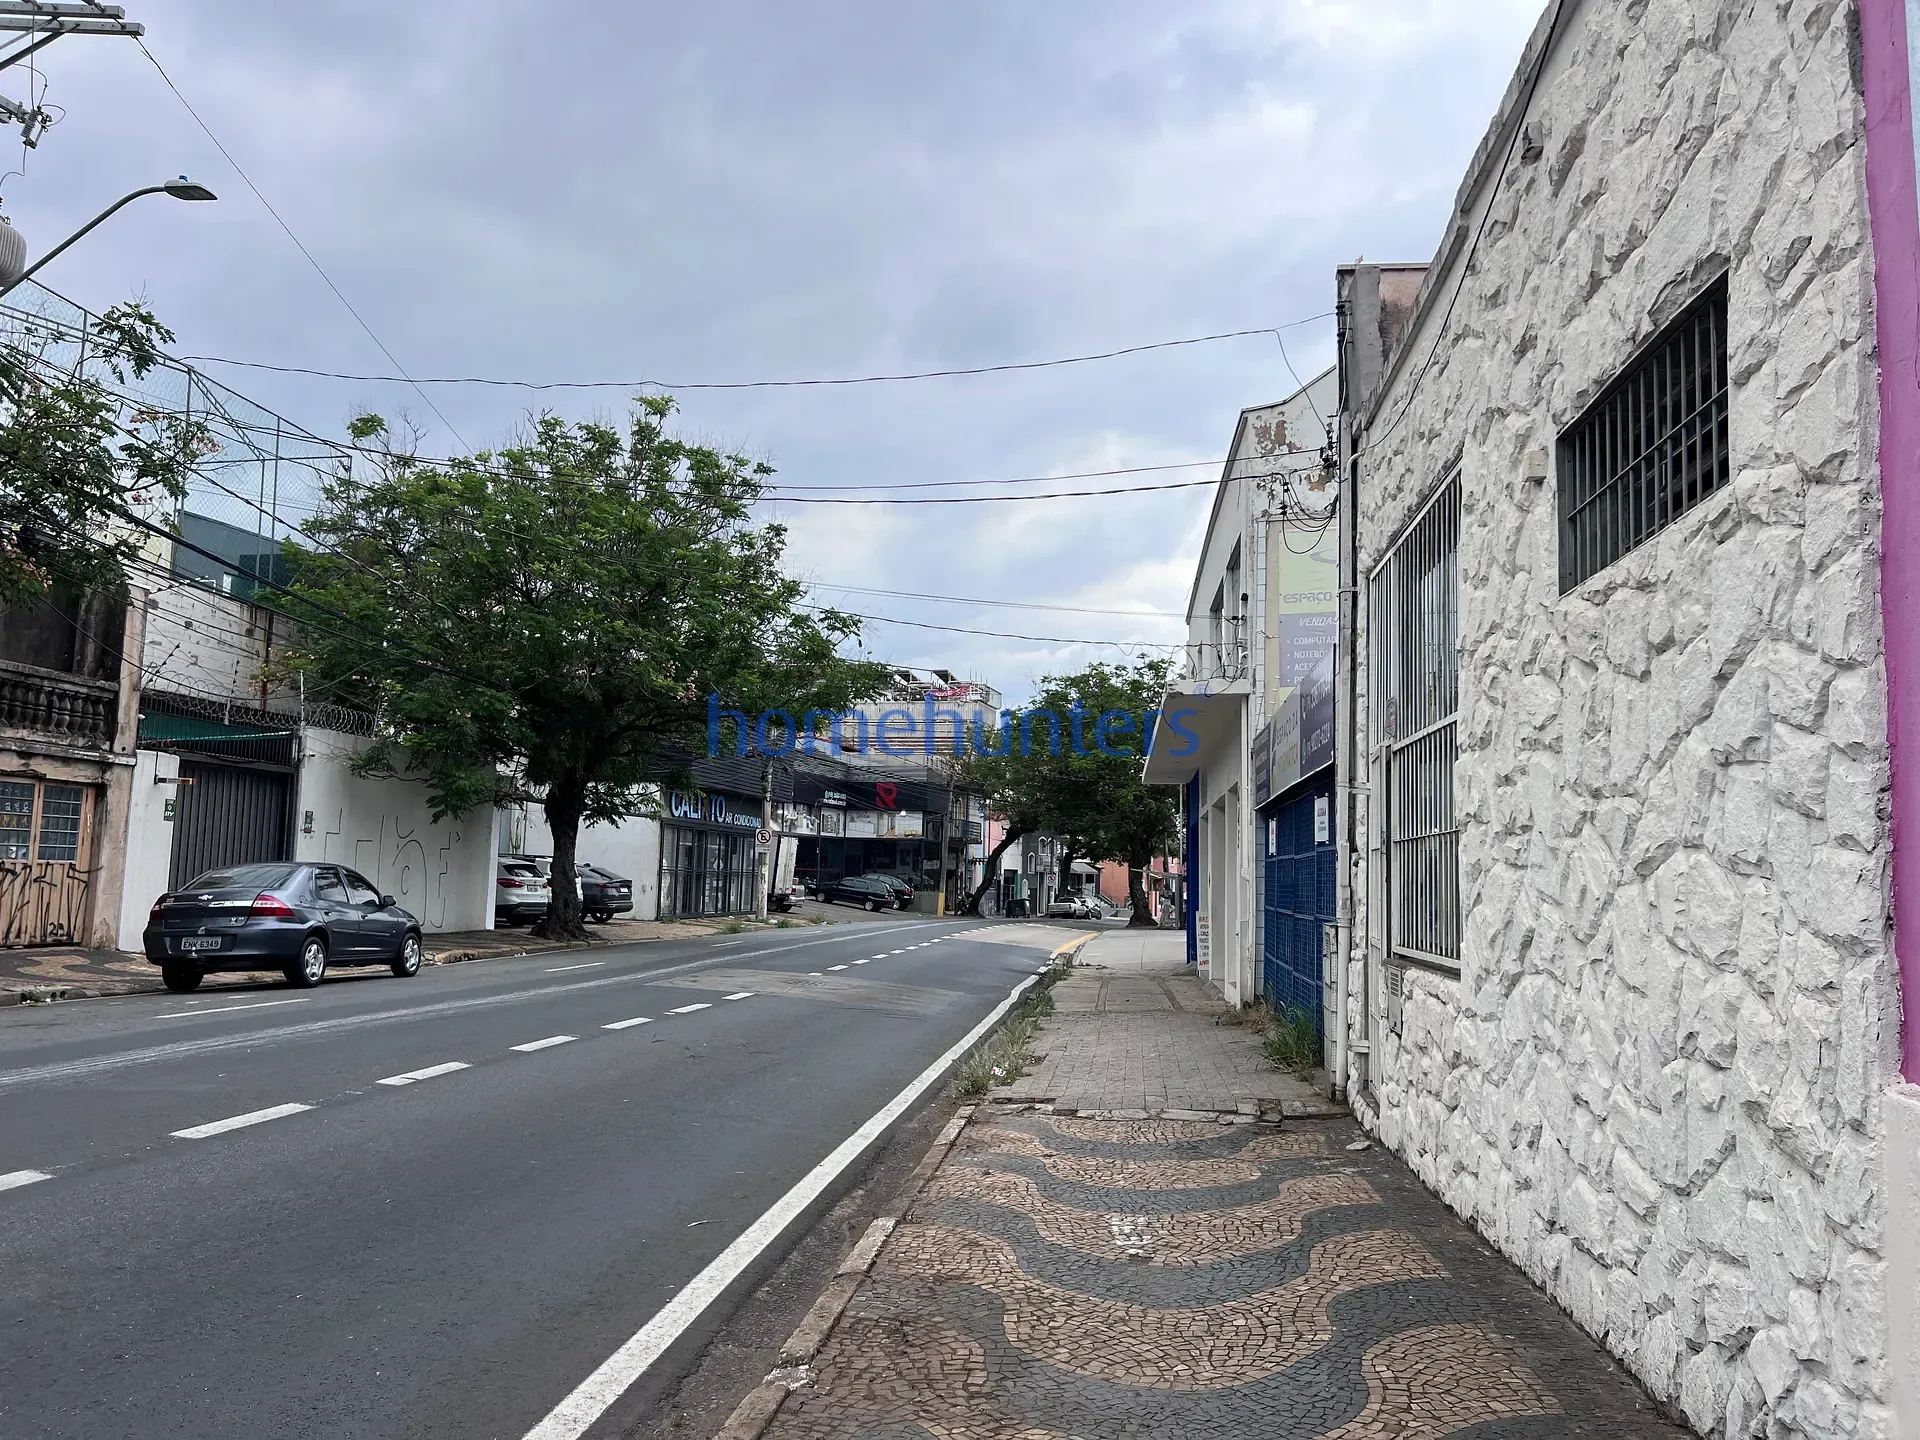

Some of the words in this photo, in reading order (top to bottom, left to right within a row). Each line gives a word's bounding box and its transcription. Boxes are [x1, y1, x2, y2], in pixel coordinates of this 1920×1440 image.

[1300, 616, 1338, 626] VENDAS
[1293, 650, 1329, 659] NOTEBO
[671, 791, 726, 822] CALITO
